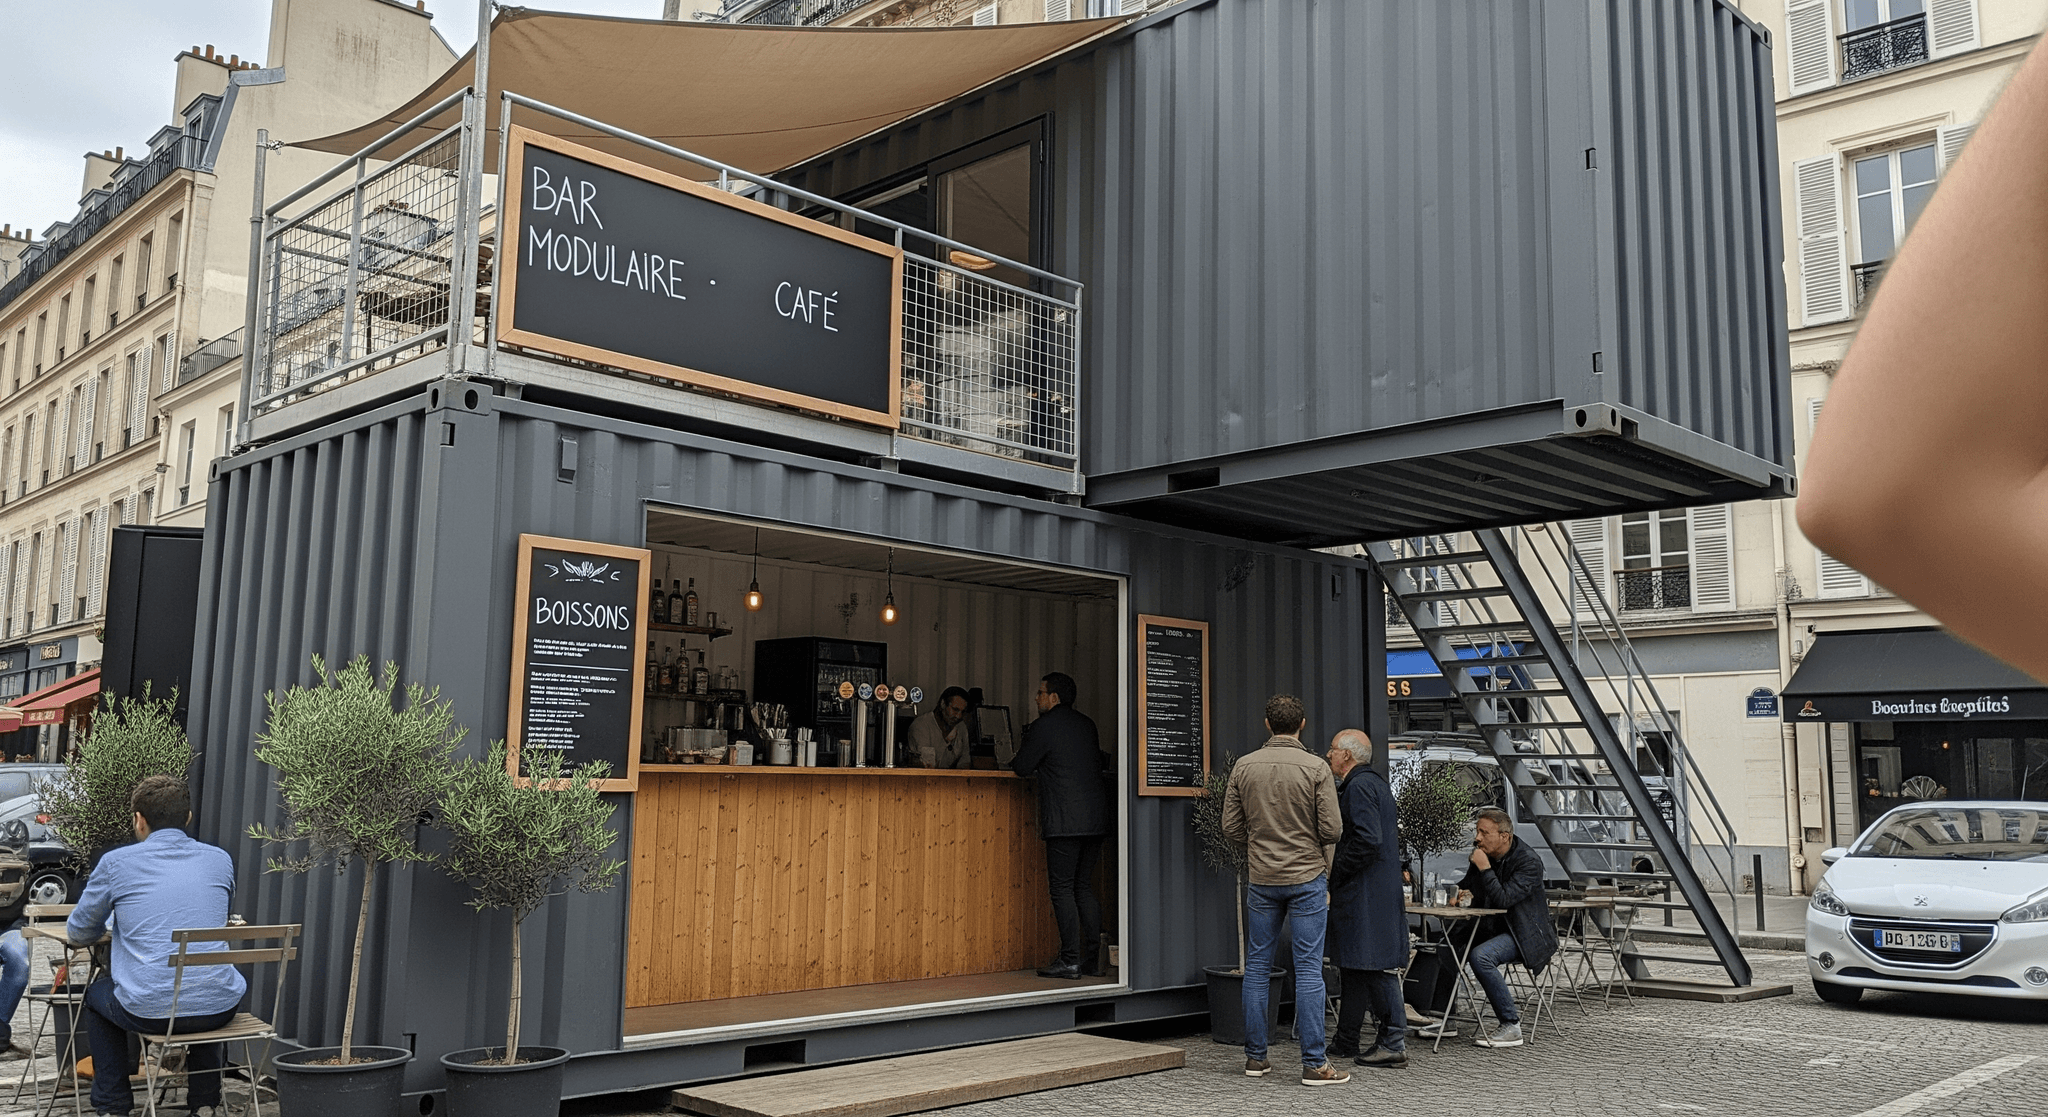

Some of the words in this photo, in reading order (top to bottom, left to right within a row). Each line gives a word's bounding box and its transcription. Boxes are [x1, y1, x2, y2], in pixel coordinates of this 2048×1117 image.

[533, 166, 603, 230] BAR
[529, 224, 687, 300] MODULAIRE
[774, 281, 839, 332] CAFÉ
[536, 597, 630, 631] BOISSONS
